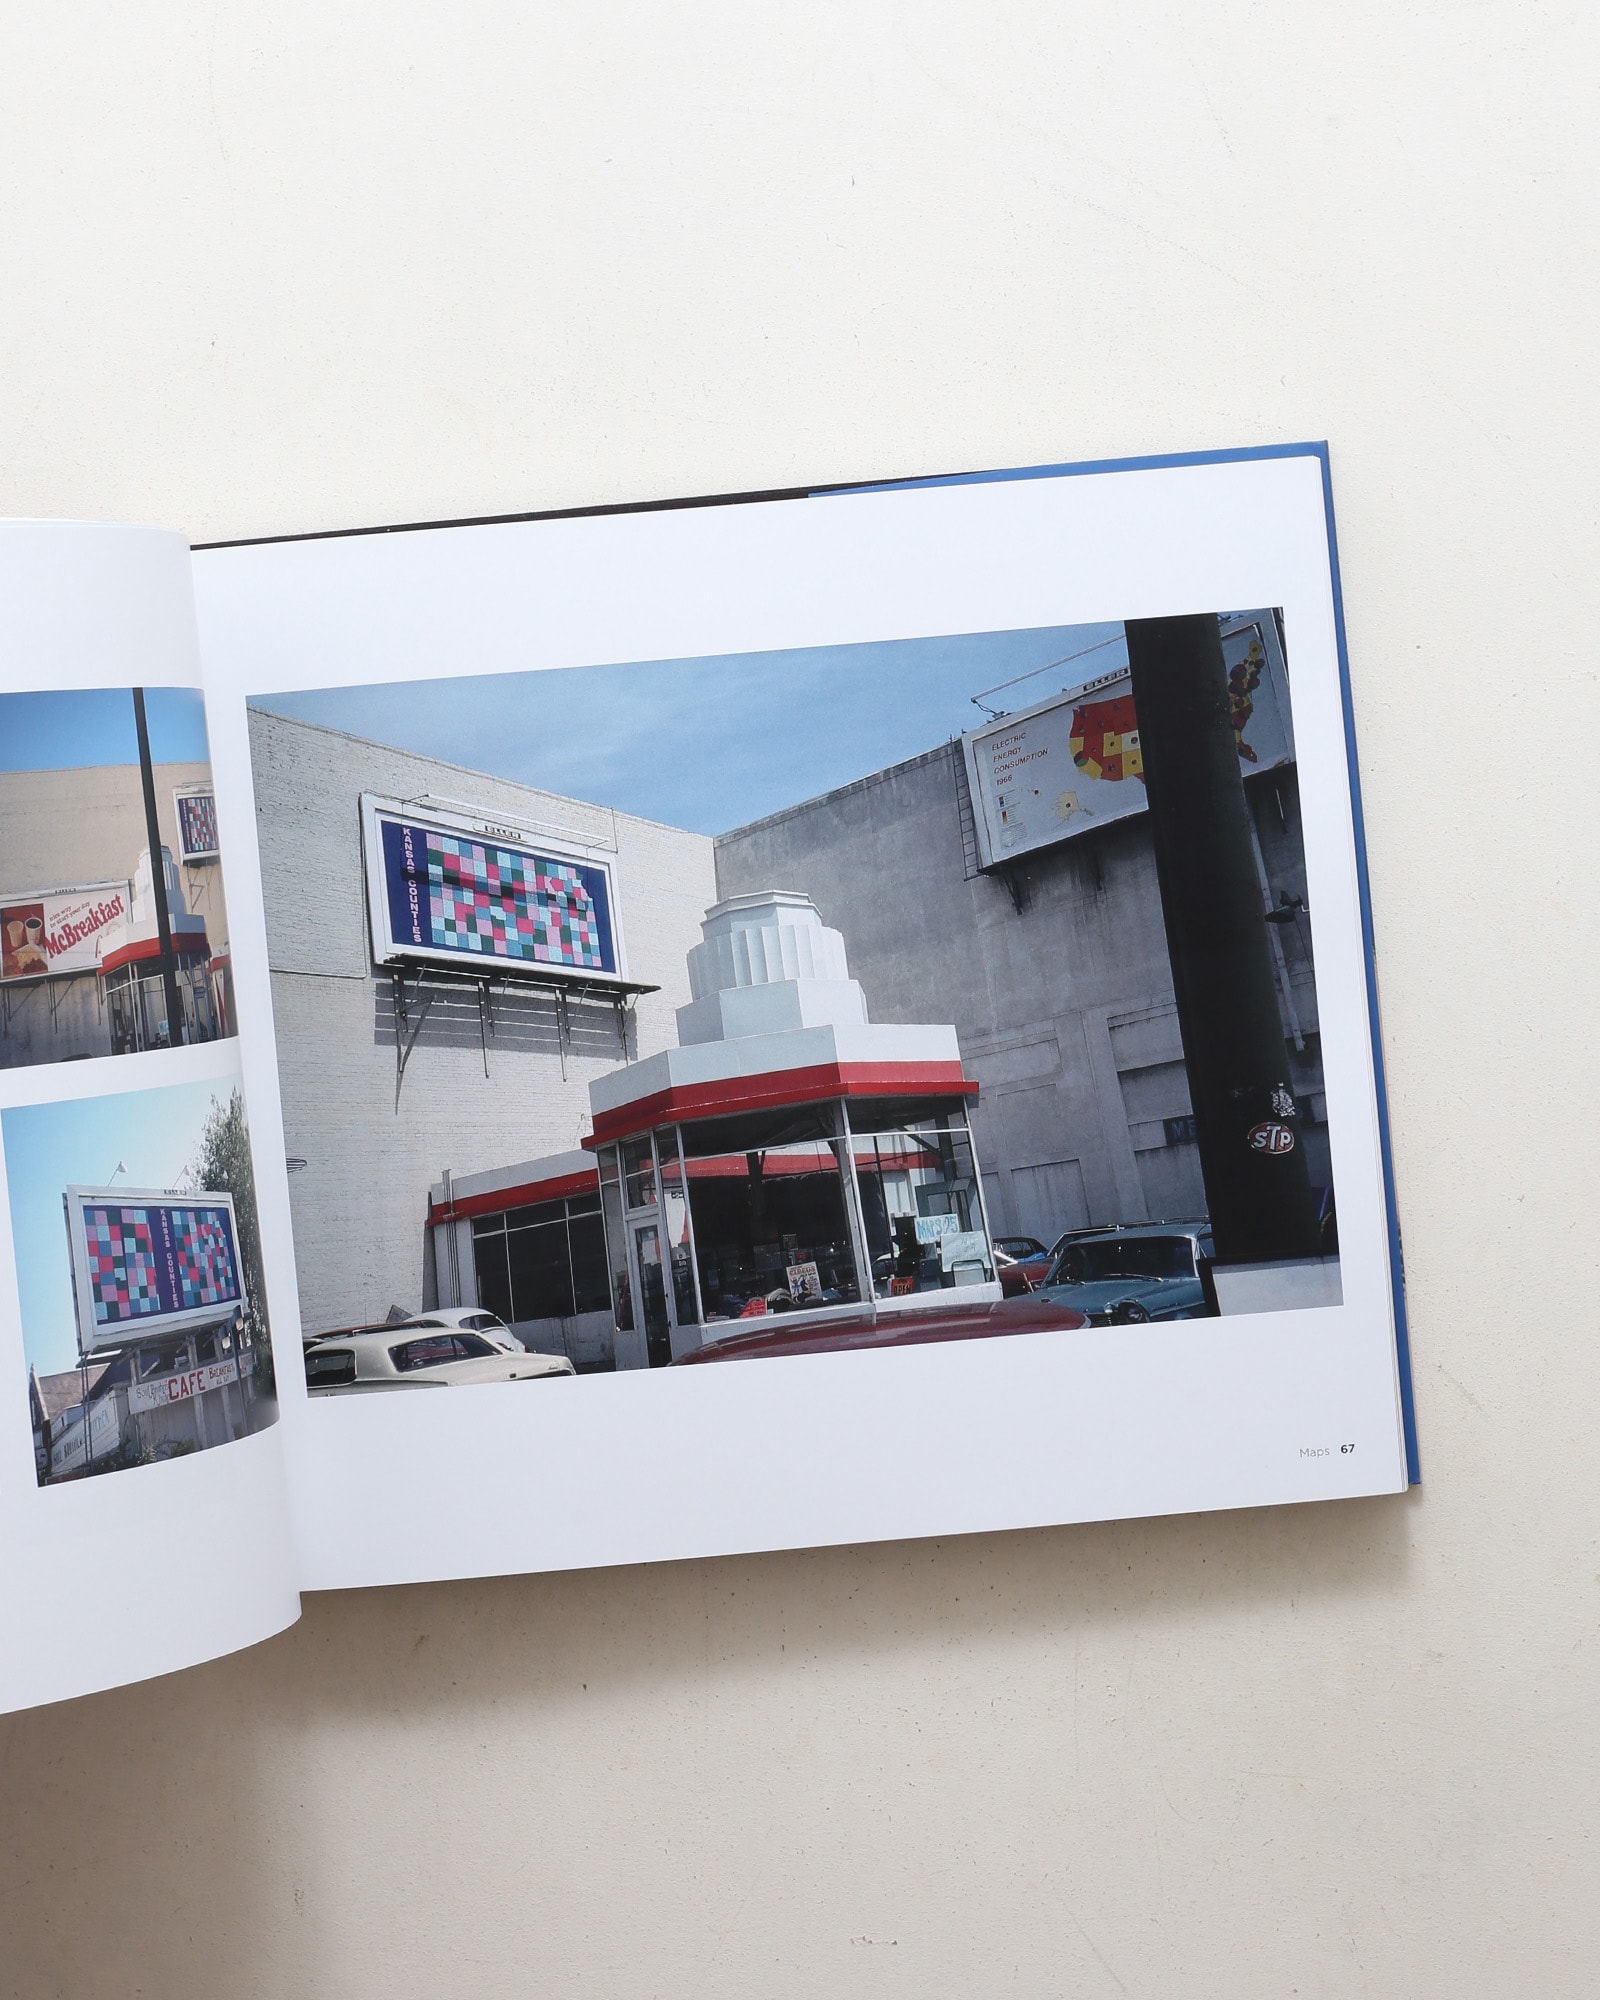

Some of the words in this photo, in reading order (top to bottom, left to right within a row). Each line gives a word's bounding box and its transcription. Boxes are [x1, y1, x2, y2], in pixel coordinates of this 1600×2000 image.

[992, 732, 1026, 751] ELECTRIC
[993, 747, 1022, 762] ENERGY
[994, 748, 1048, 774] CONSUMPTION
[403, 827, 415, 874] KANSAS
[408, 880, 422, 942] COUNTIES
[45, 894, 124, 959] McBreakfast
[1253, 1125, 1291, 1150] STP
[160, 1208, 171, 1248] KANSAS
[167, 1253, 179, 1308] COUNTIES
[168, 1371, 206, 1401] CAFE
[1299, 1448, 1330, 1458] Maps
[1340, 1443, 1355, 1454] 67
